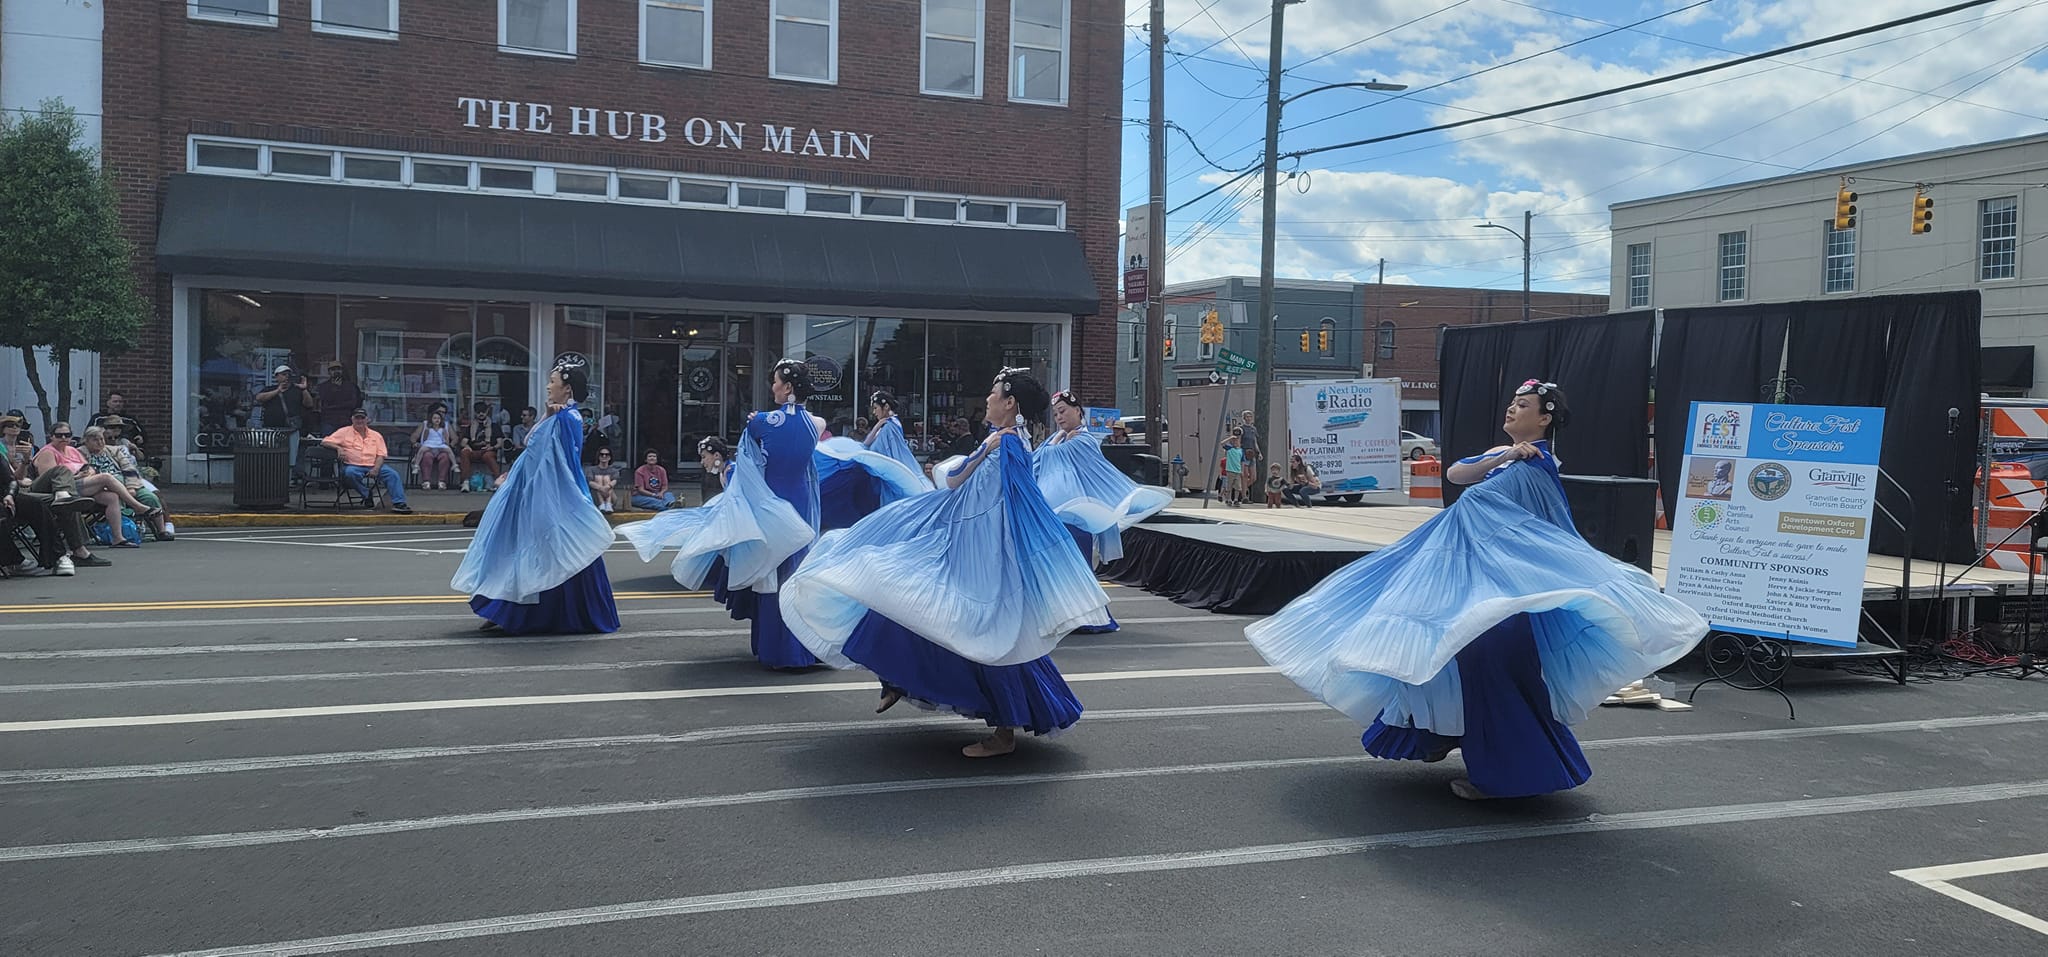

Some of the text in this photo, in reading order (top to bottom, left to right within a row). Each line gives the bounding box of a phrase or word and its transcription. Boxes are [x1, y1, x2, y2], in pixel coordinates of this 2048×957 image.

[457, 97, 875, 160] THE HUB ON MAIN
[1230, 354, 1256, 369] MAIN ST
[1328, 386, 1372, 394] Next Door
[1329, 394, 1372, 409] Radio
[1705, 412, 1739, 423] Culture
[1703, 422, 1740, 437] FEST
[195, 432, 235, 448] CRA
[1773, 431, 1844, 454] Sponsors
[1309, 446, 1344, 455] PLATINUM
[1809, 468, 1866, 487] Granville
[1805, 494, 1868, 505] Granville County
[1727, 503, 1746, 511] North
[1840, 502, 1863, 510] Board
[1726, 511, 1753, 519] Carolina
[1783, 516, 1855, 528] Downtown Oxford
[1781, 523, 1855, 536] Development Corp
[1690, 530, 1718, 541] Thank
[1717, 536, 1734, 545] you
[1746, 538, 1776, 547] everyone
[1778, 540, 1793, 548] who
[1794, 543, 1814, 552] gave
[1816, 543, 1823, 551] to
[1826, 544, 1847, 553] make
[1680, 566, 1704, 574] William
[1711, 569, 1728, 577] Cathy
[1700, 556, 1829, 577] COMMUNITY SPONSORS
[1714, 592, 1742, 600] Solutions
[1789, 593, 1809, 601] Nancy
[1745, 602, 1767, 610] Baptist
[1768, 605, 1791, 613] Church
[1712, 613, 1735, 622] Darling
[1736, 616, 1776, 627] Presbyterian
[1777, 622, 1801, 630] Church
[1803, 625, 1828, 633] Women
[1751, 611, 1783, 620] Methodist
[1784, 615, 1807, 623] Church
